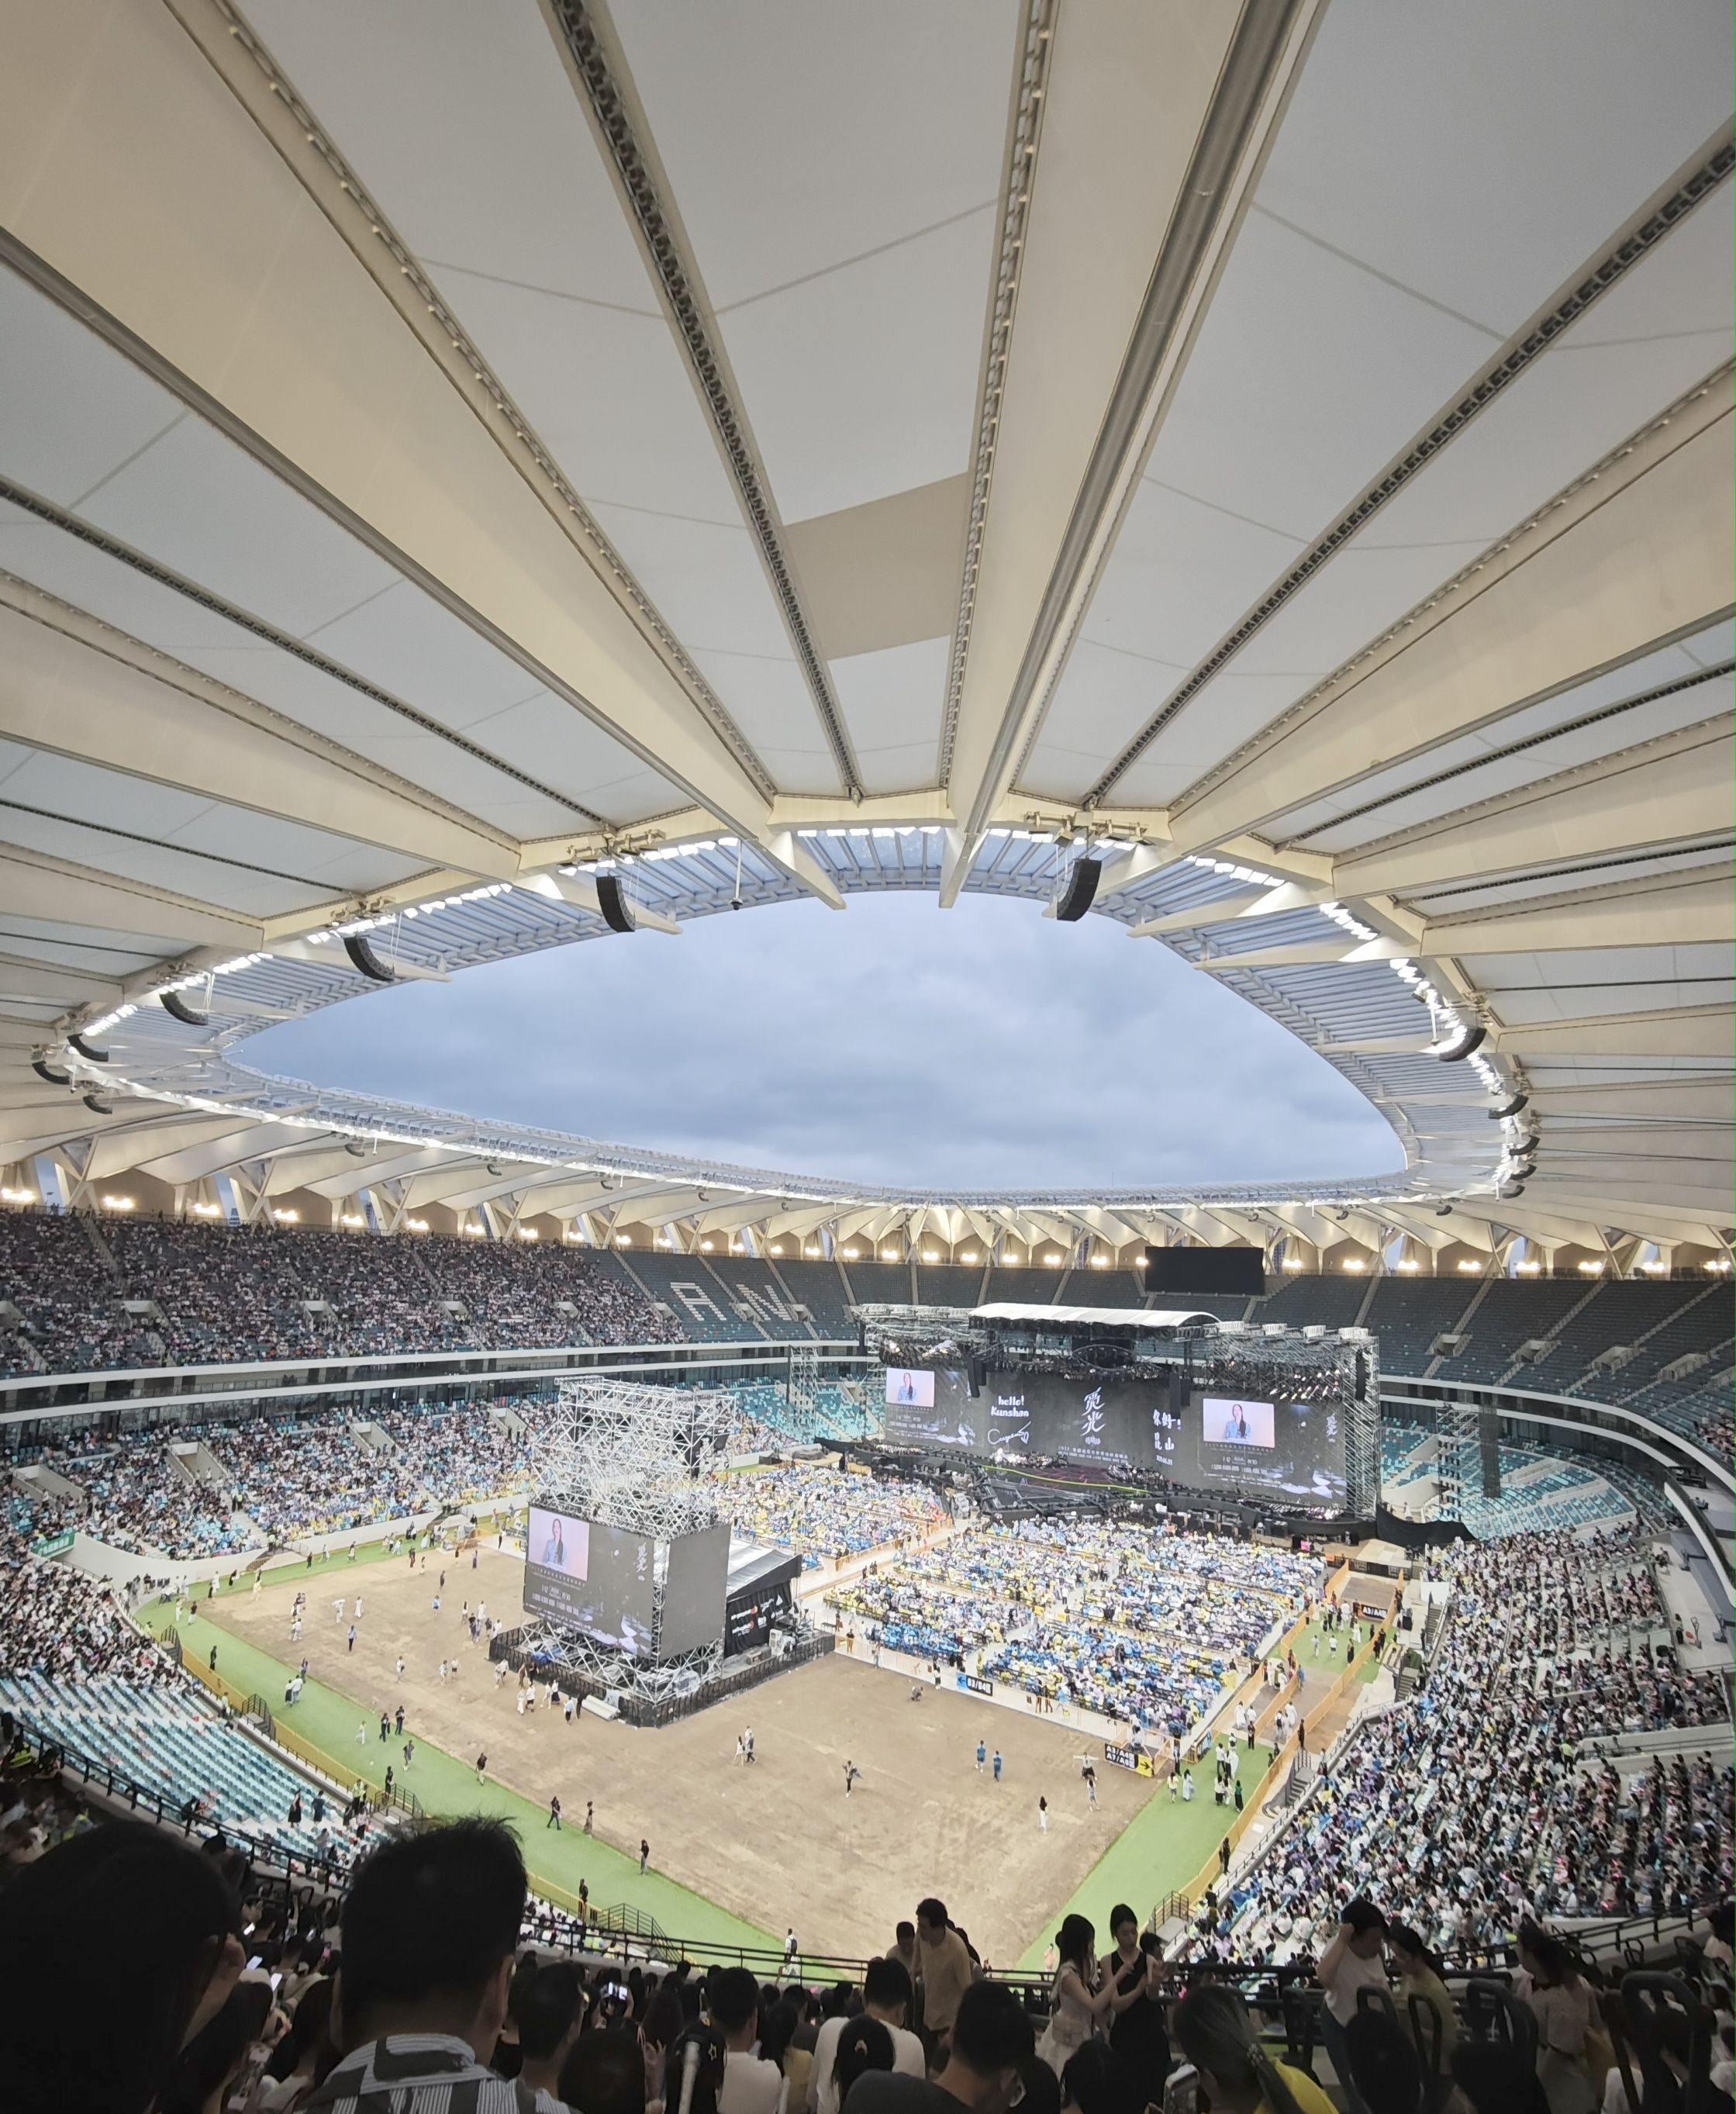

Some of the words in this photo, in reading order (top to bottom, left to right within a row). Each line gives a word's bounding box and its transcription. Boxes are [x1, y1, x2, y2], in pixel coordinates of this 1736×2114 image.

[998, 1395, 1025, 1406] hello!
[990, 1405, 1030, 1418] Kunshan
[1154, 1432, 1175, 1450] 昆山
